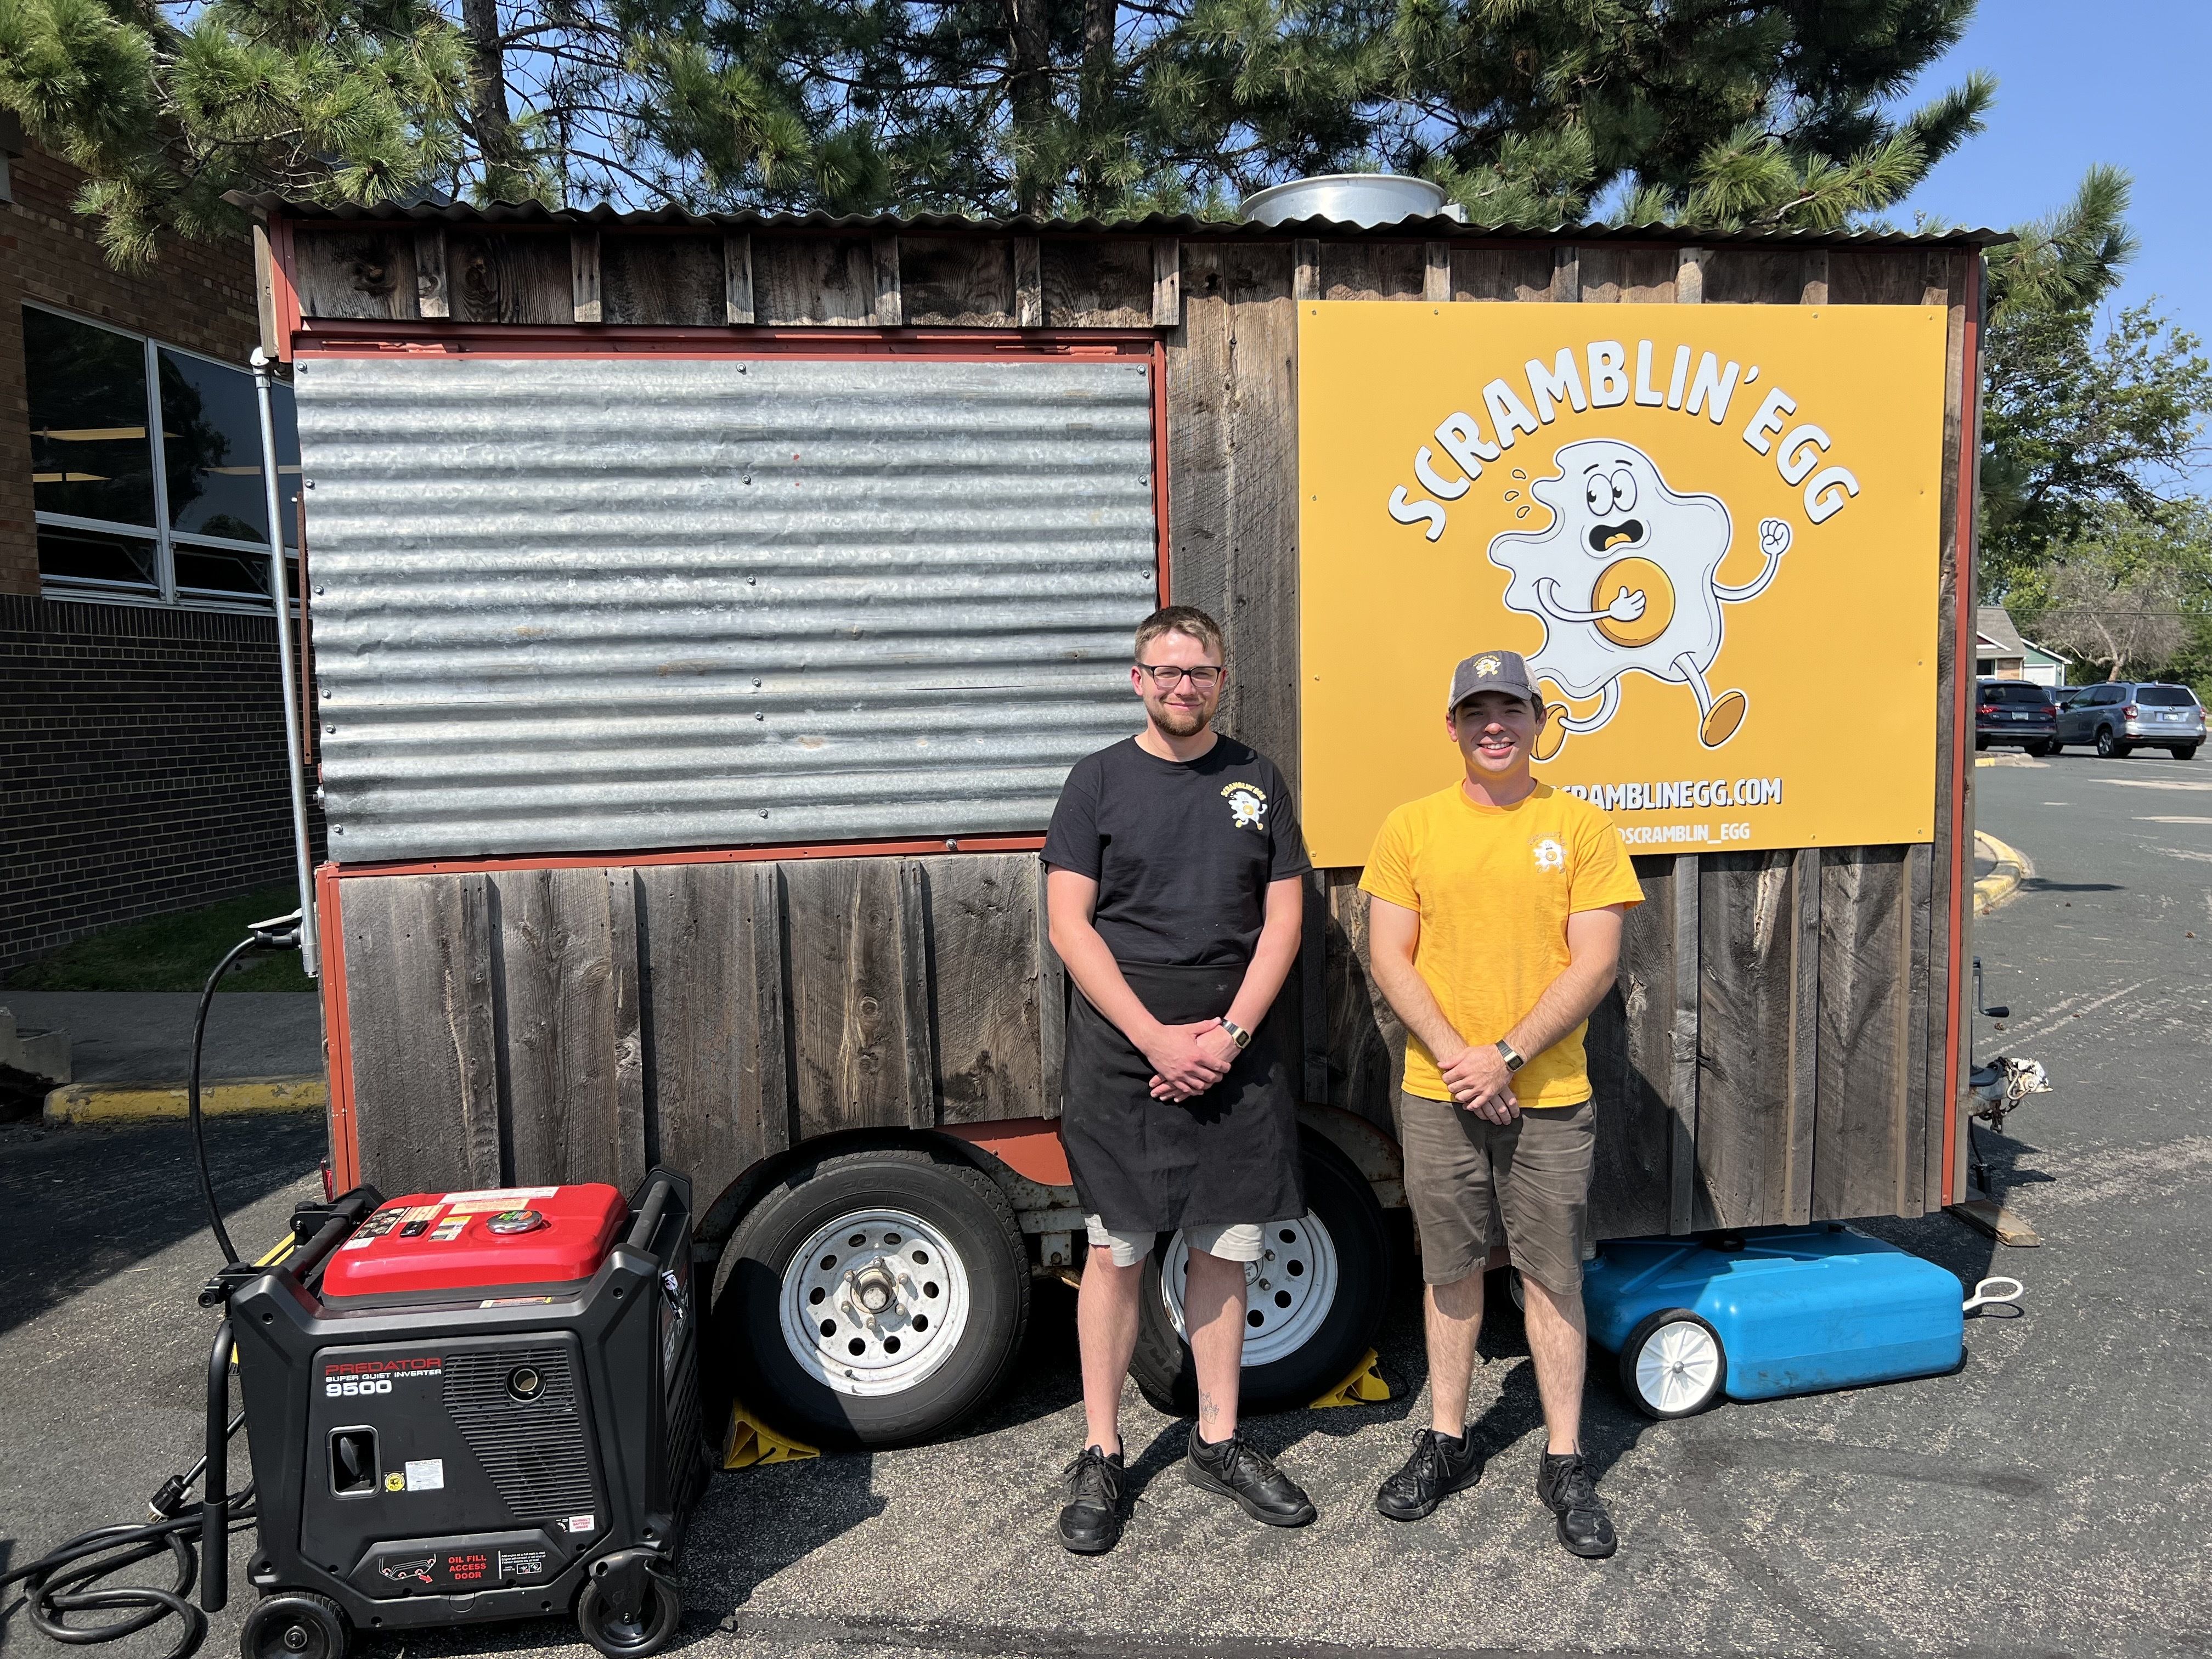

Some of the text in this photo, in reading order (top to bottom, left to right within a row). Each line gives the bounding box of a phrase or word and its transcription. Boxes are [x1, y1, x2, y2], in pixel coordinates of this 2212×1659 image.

[1388, 340, 1859, 543] SCRAMBLIN' EGG
[1549, 777, 1782, 811] RAMBLINEGG.COM
[325, 1358, 441, 1375] PREDATOR
[326, 1369, 442, 1383] SUPER QUIET INVERTER
[326, 1379, 392, 1397] 9500
[449, 1563, 487, 1572] ACCESS
[455, 1571, 481, 1580] DOOR
